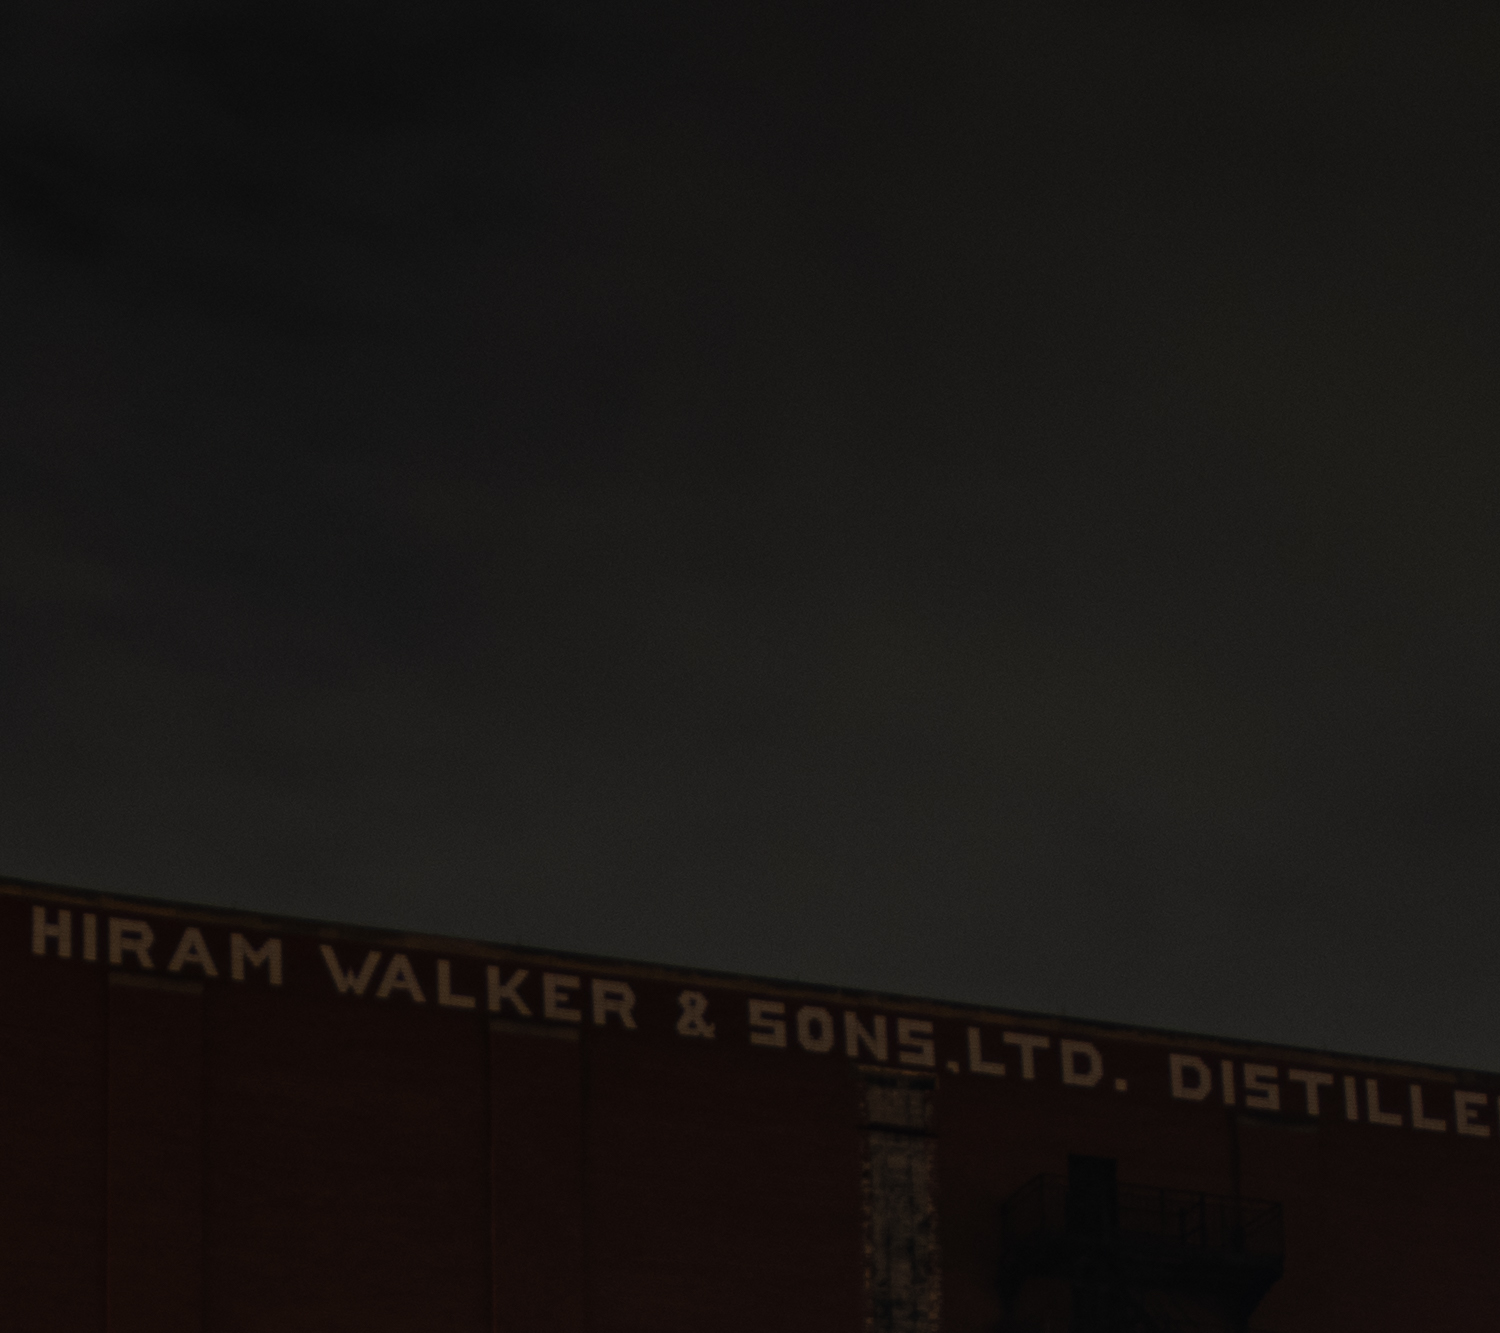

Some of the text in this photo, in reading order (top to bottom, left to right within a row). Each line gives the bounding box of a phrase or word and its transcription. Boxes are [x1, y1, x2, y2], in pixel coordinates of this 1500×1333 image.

[32, 905, 283, 987] HIRAM
[319, 944, 637, 1030] WALKER
[676, 990, 716, 1039] &
